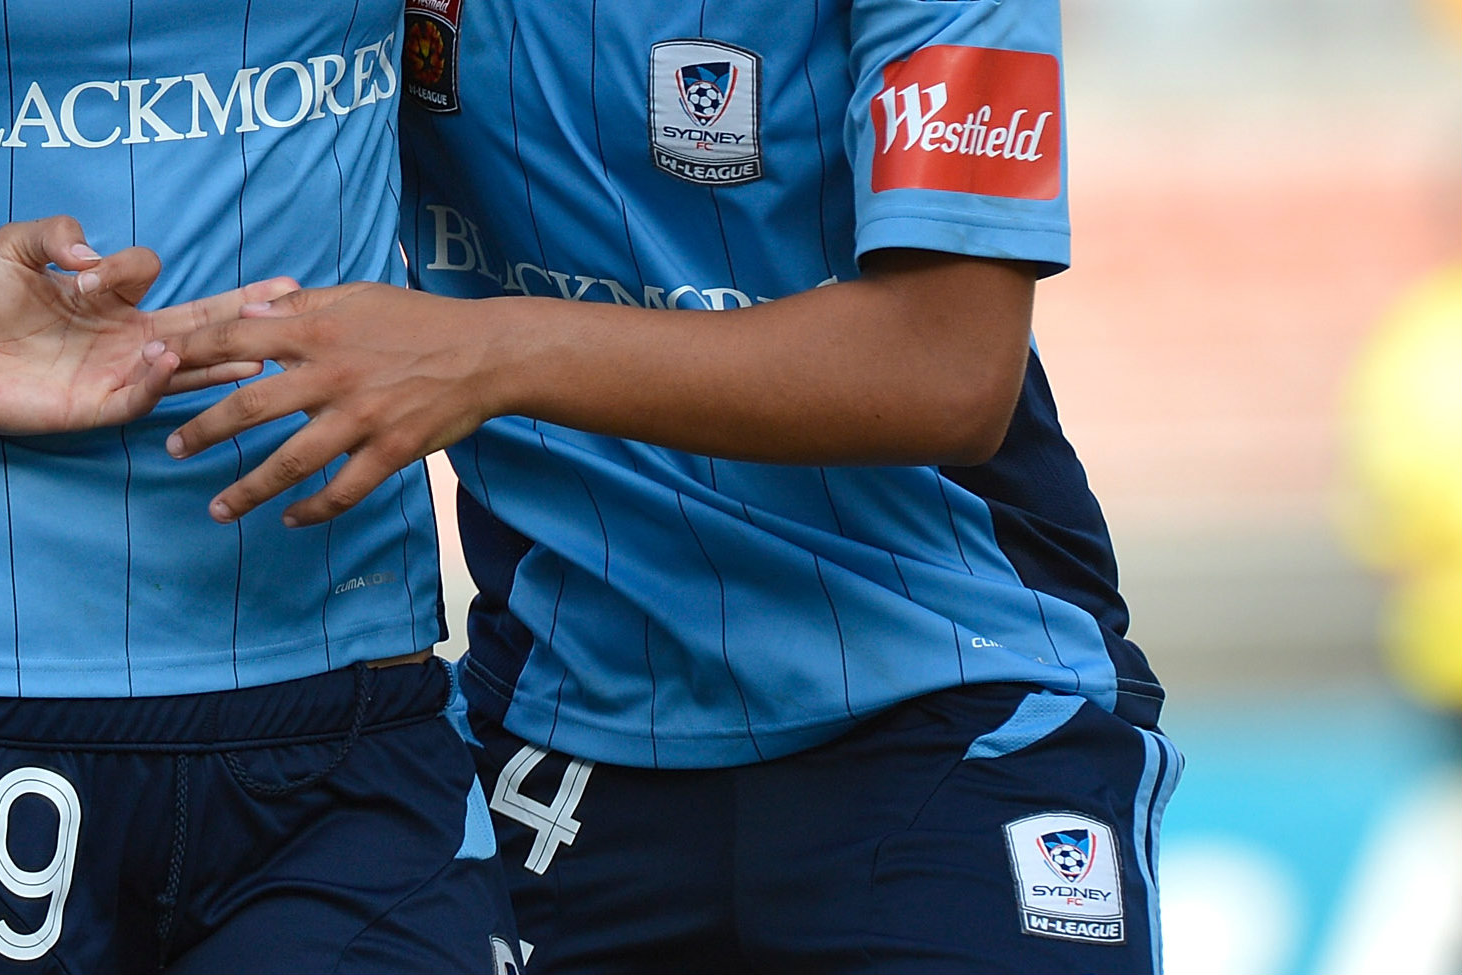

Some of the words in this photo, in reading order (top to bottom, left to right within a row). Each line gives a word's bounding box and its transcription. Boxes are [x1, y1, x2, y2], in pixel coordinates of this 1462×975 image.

[876, 81, 1054, 162] Westfield
[662, 125, 746, 145] SYDNEY
[696, 141, 714, 151] FC
[660, 154, 755, 180] W-LEAGUE
[489, 743, 596, 876] 4
[1031, 885, 1112, 902] SYDNEY
[1066, 897, 1084, 907] FC
[1029, 914, 1120, 938] W-LEAGUE
